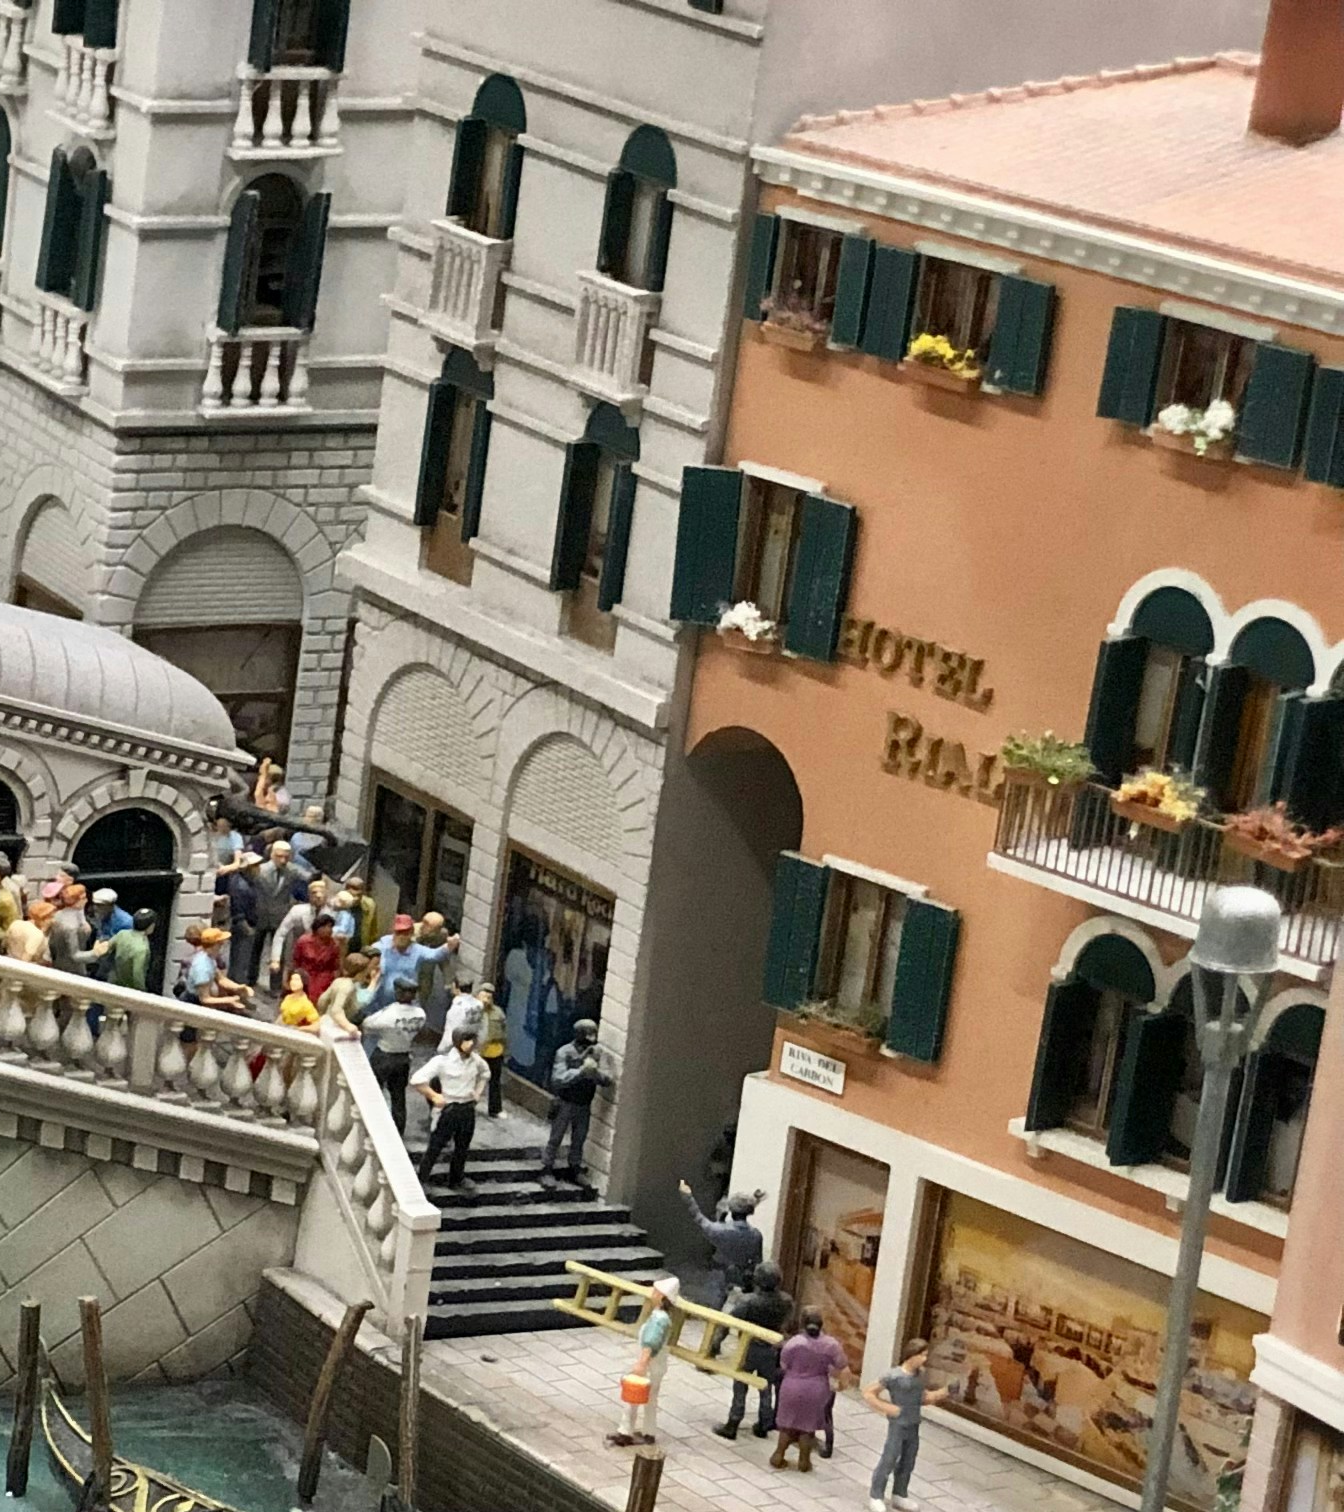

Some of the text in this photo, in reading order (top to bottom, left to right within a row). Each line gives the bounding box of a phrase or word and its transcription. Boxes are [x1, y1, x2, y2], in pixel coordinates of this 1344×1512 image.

[838, 618, 994, 714] HOTEL
[788, 1046, 840, 1073] RIVA DEL
[790, 1062, 834, 1087] CARBON
